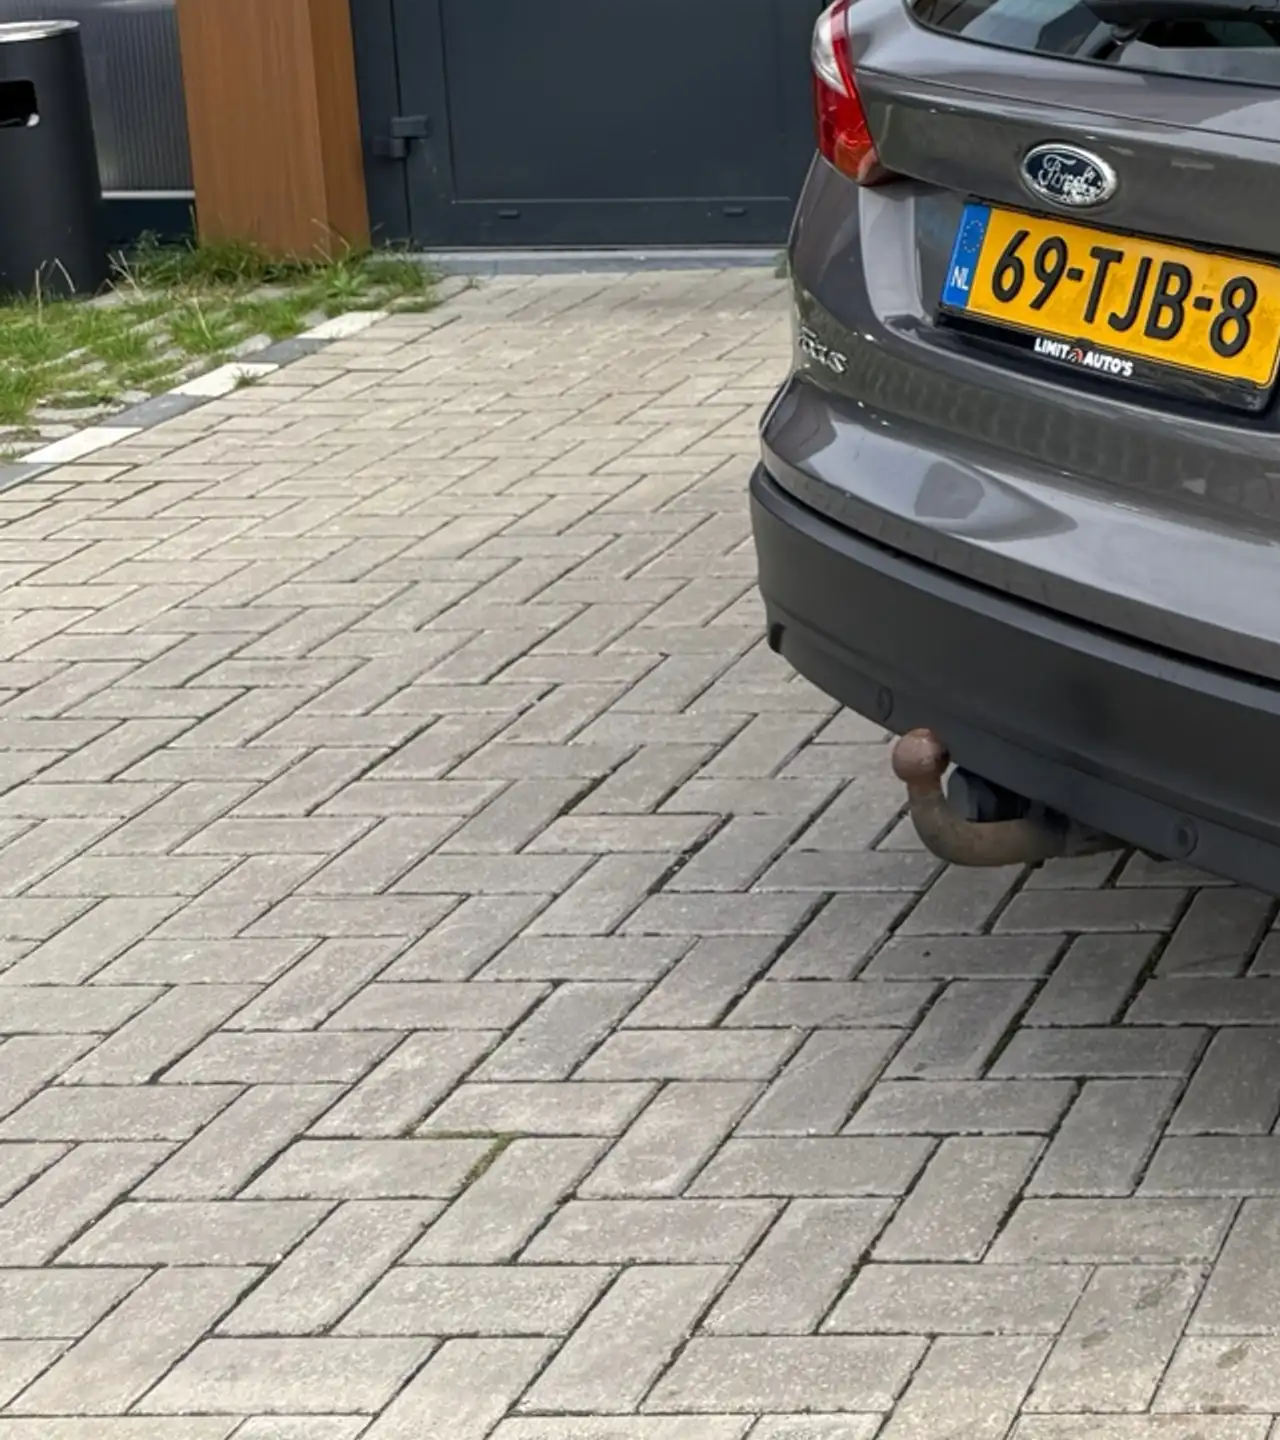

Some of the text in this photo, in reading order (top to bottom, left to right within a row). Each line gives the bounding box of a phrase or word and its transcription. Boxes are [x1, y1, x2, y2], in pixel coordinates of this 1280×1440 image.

[950, 265, 970, 292] NL
[991, 229, 1258, 358] 69-TJB-8
[1034, 337, 1070, 360] LIMIT
